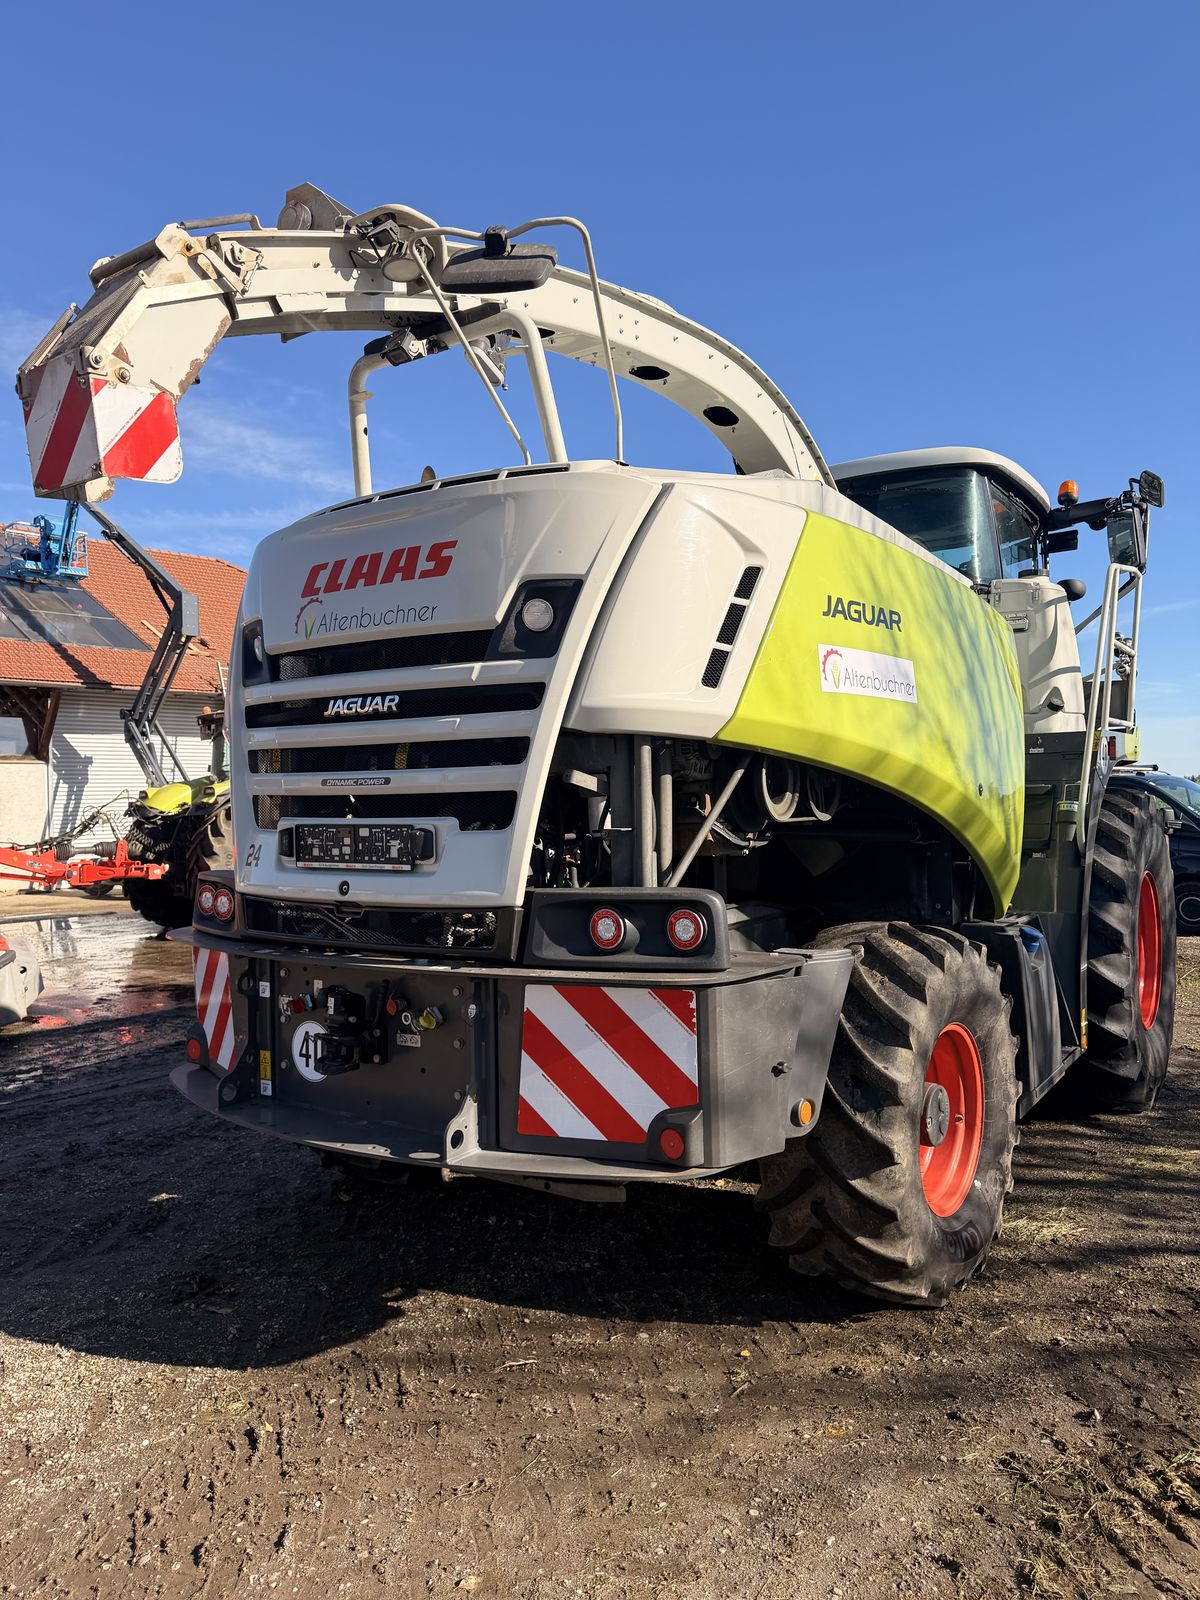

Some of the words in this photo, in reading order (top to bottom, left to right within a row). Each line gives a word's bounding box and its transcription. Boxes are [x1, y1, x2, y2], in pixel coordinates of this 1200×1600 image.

[300, 539, 459, 599] CLAAS
[316, 604, 438, 635] Altenbuchner
[822, 594, 902, 632] JAGUAR
[843, 668, 915, 697] Altenbuchner
[323, 694, 400, 717] JAGUAR
[245, 843, 263, 867] 24
